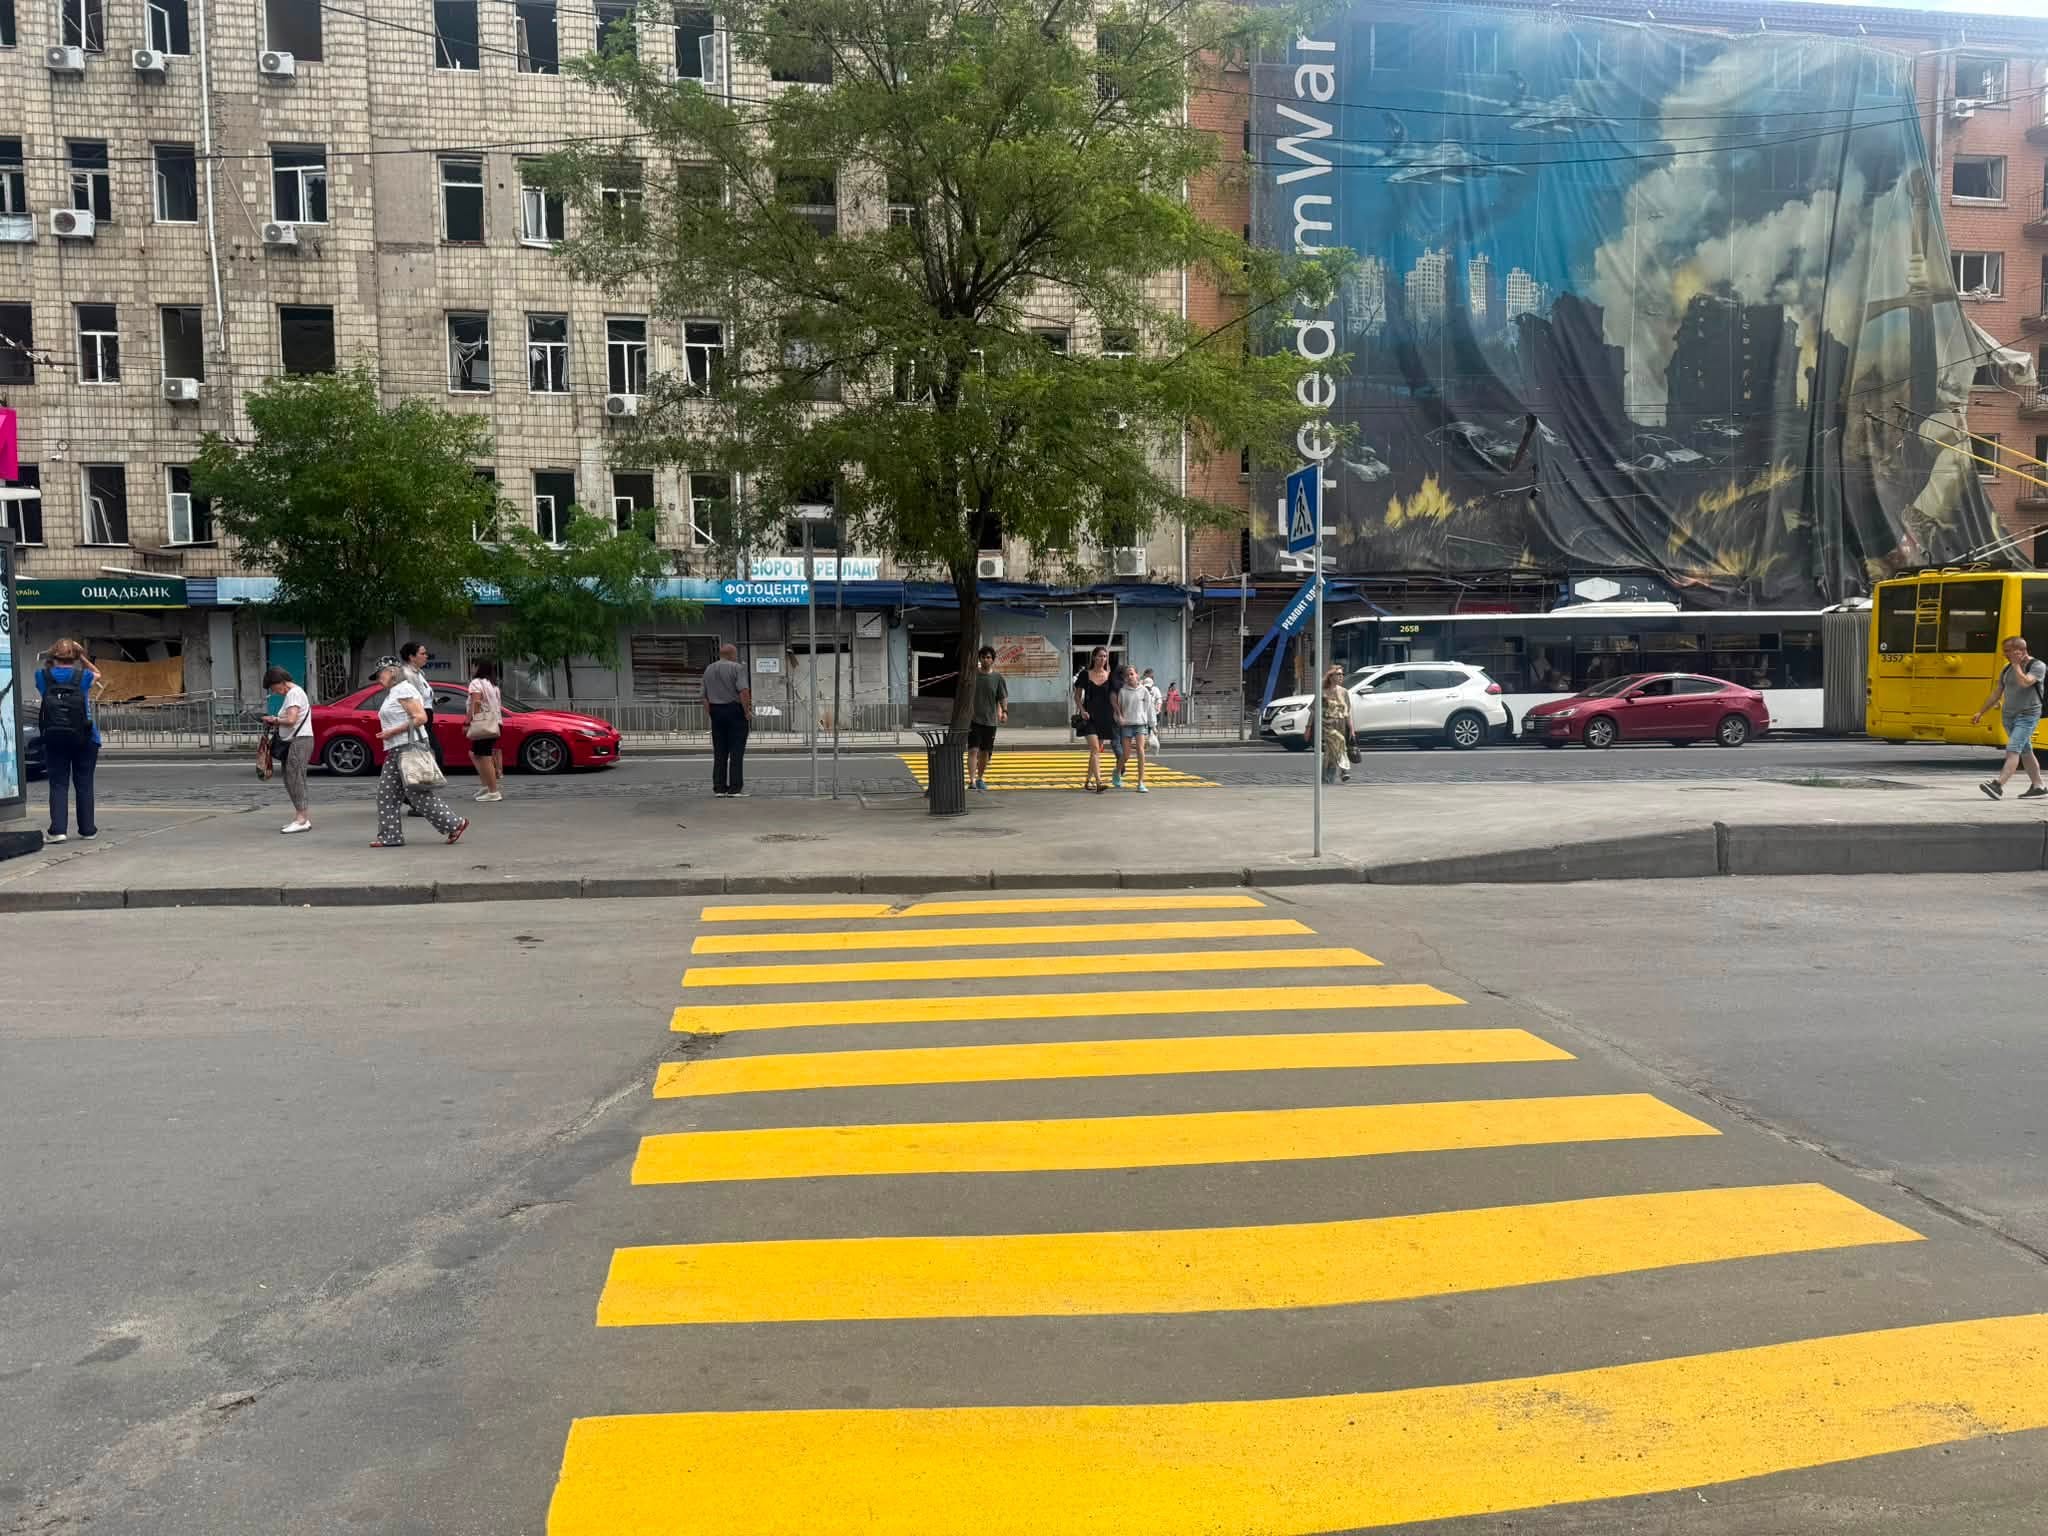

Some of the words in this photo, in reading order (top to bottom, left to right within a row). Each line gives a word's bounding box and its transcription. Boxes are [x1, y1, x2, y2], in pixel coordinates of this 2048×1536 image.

[751, 560, 793, 577] БЮРО
[81, 586, 171, 600] ОЩАДБАНК
[724, 583, 809, 596] ФОТОЦЕНТР
[734, 596, 800, 604] ФОТОСАЛОН
[1281, 599, 1309, 631] РЕМОНТ
[1881, 654, 1904, 663] 3357
